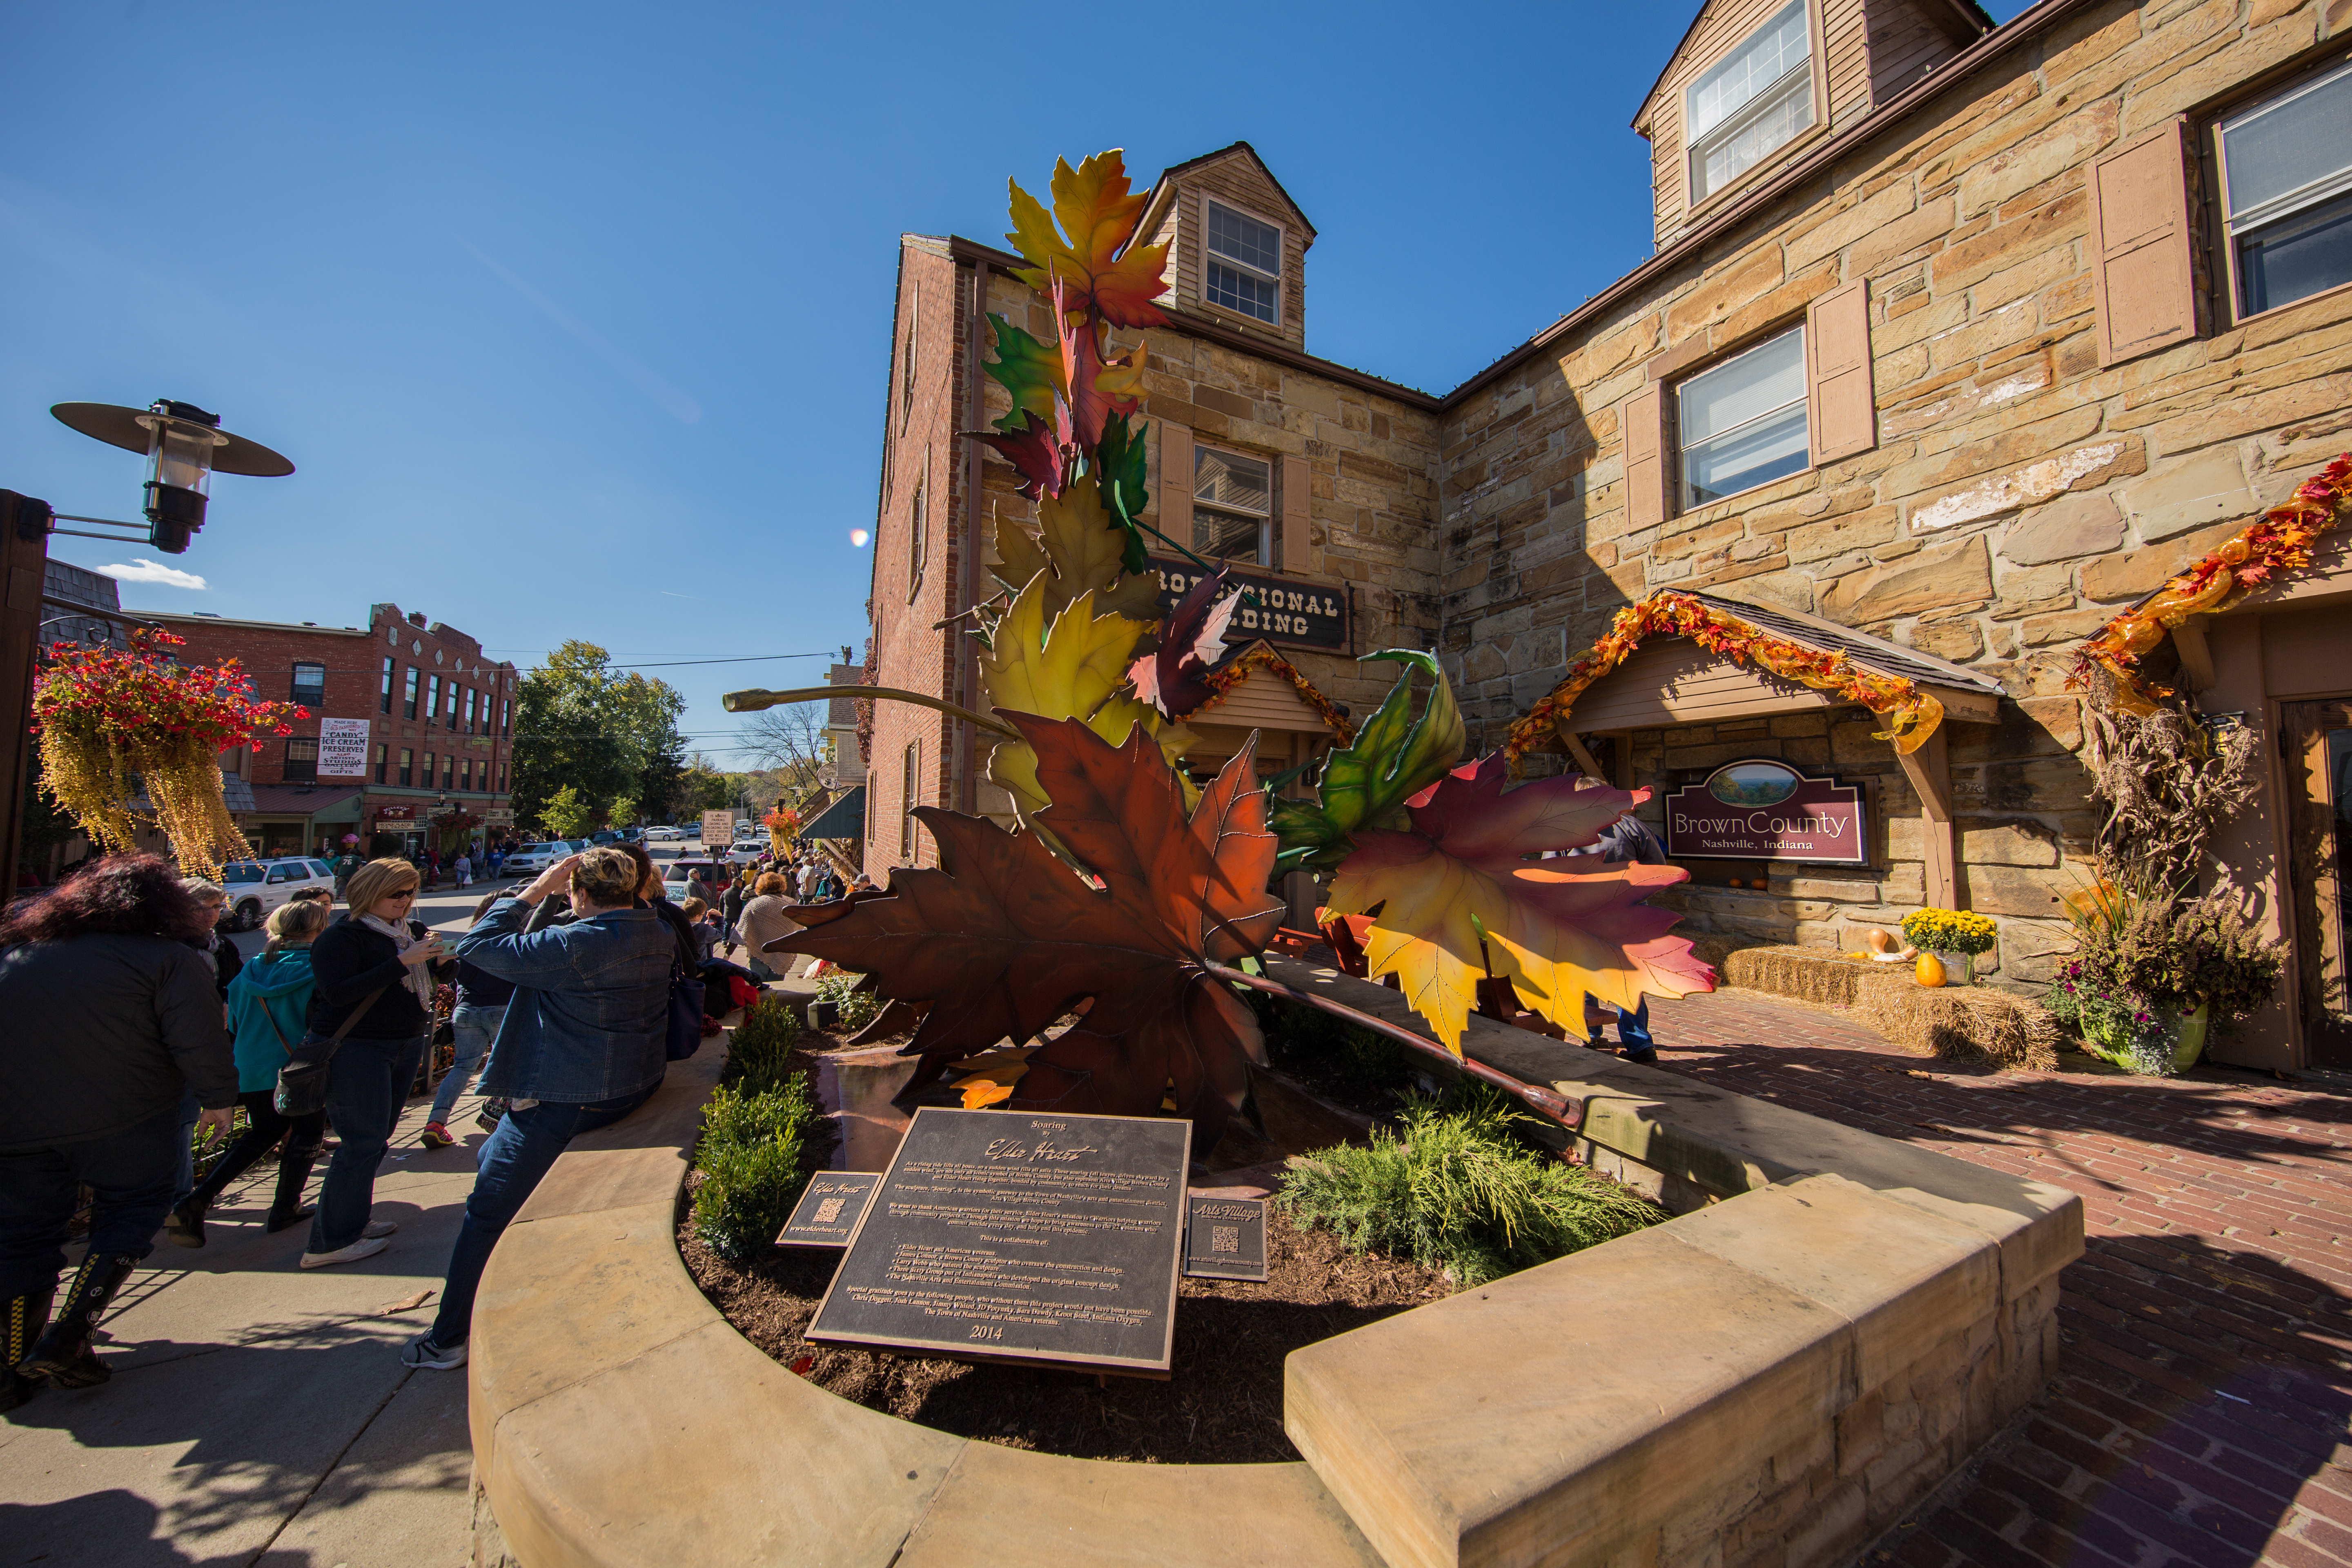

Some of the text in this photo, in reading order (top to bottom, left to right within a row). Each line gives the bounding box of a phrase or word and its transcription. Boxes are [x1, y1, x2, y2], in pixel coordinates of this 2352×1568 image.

[1702, 839, 1814, 850] Nashville, Indiana
[1031, 1120, 1067, 1131] Soaring
[985, 1139, 1098, 1162] Elder Heart
[813, 1183, 869, 1194] Elder Heart
[1193, 1204, 1261, 1221] Arts Village
[790, 1226, 848, 1235] www.elderheart.org
[983, 1257, 1008, 1265] sculptor
[1102, 1266, 1125, 1274] design.
[1189, 1256, 1263, 1267] www.artsvillagebrowncounty.com
[972, 1264, 1001, 1272] sculpture.
[953, 1278, 994, 1286] Entertainment
[993, 1281, 1032, 1289] Commission.
[961, 1271, 997, 1280] Indianapolis
[1010, 1274, 1041, 1283] developed
[1051, 1278, 1075, 1286] original
[1074, 1280, 1098, 1288] concept
[1098, 1281, 1121, 1290] design.
[845, 1285, 869, 1294] Special
[867, 1287, 894, 1296] gratitude
[924, 1292, 954, 1301] following
[953, 1294, 977, 1303] people,
[1041, 1301, 1063, 1310] project
[1126, 1308, 1154, 1317] possible.
[867, 1296, 895, 1304] Doggett,
[907, 1298, 933, 1307] Lannon,
[931, 1301, 952, 1309] Jimmy
[952, 1302, 977, 1311] Whited,
[986, 1305, 1016, 1314] Potynsky,
[1030, 1309, 1054, 1318] Dawdy,
[1091, 1314, 1116, 1322] Indiana
[1115, 1316, 1143, 1325] Oxygen,
[961, 1311, 991, 1319] Nashville
[1002, 1314, 1032, 1323] American
[969, 1325, 1004, 1340] 2014
